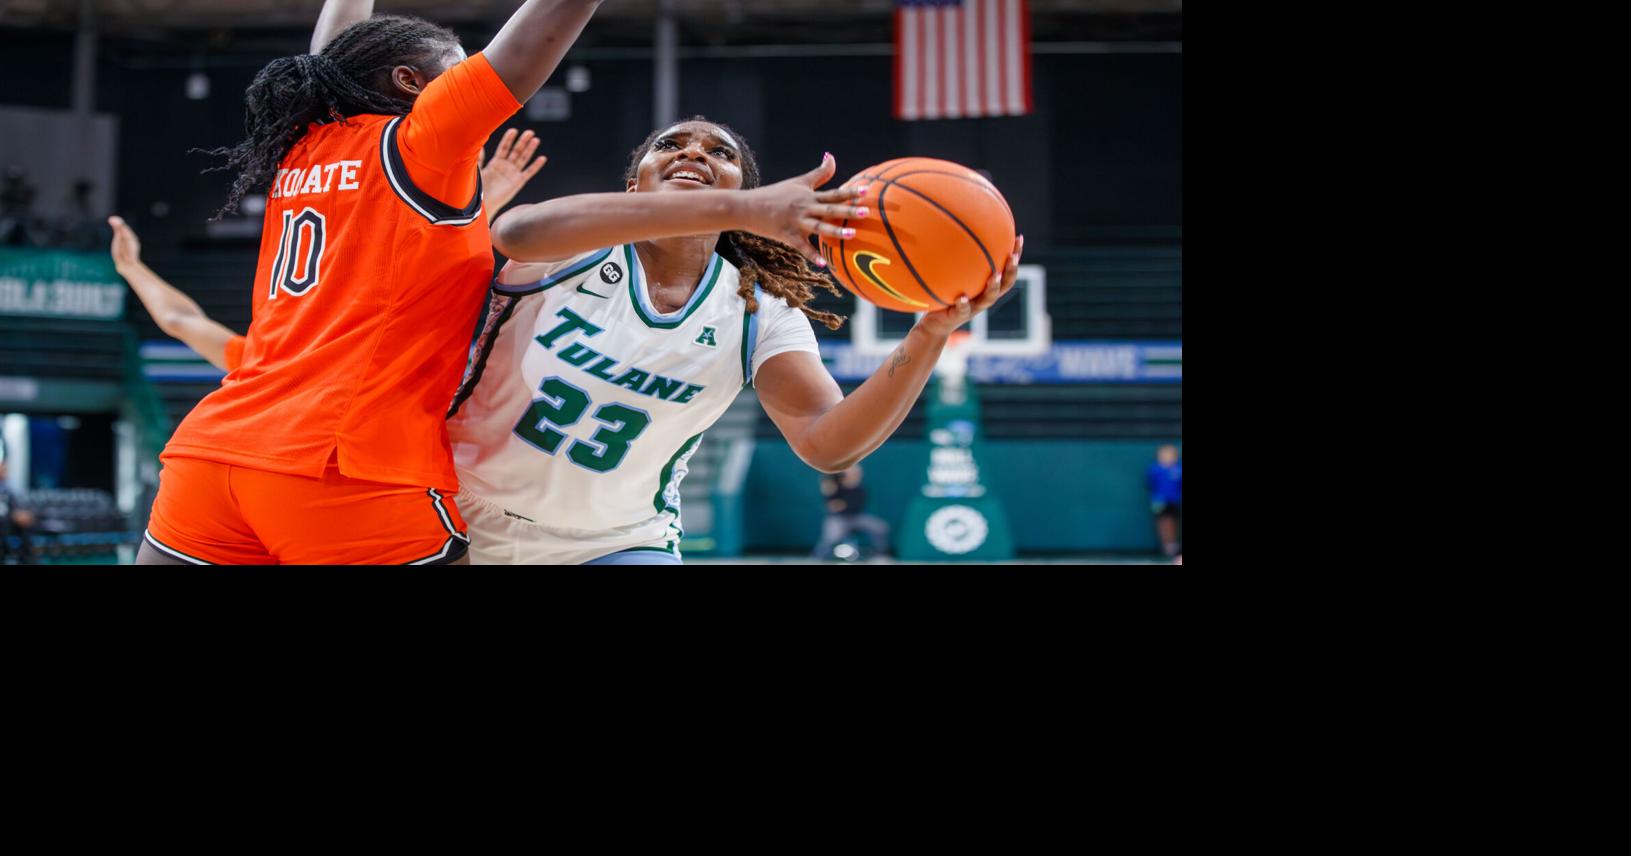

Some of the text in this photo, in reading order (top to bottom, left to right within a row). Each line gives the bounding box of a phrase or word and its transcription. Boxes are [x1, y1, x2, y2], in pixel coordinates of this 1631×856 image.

[268, 206, 326, 300] 10
[602, 263, 620, 283] GG
[534, 306, 706, 404] TULANE
[693, 325, 718, 348] A
[512, 375, 652, 474] 23
